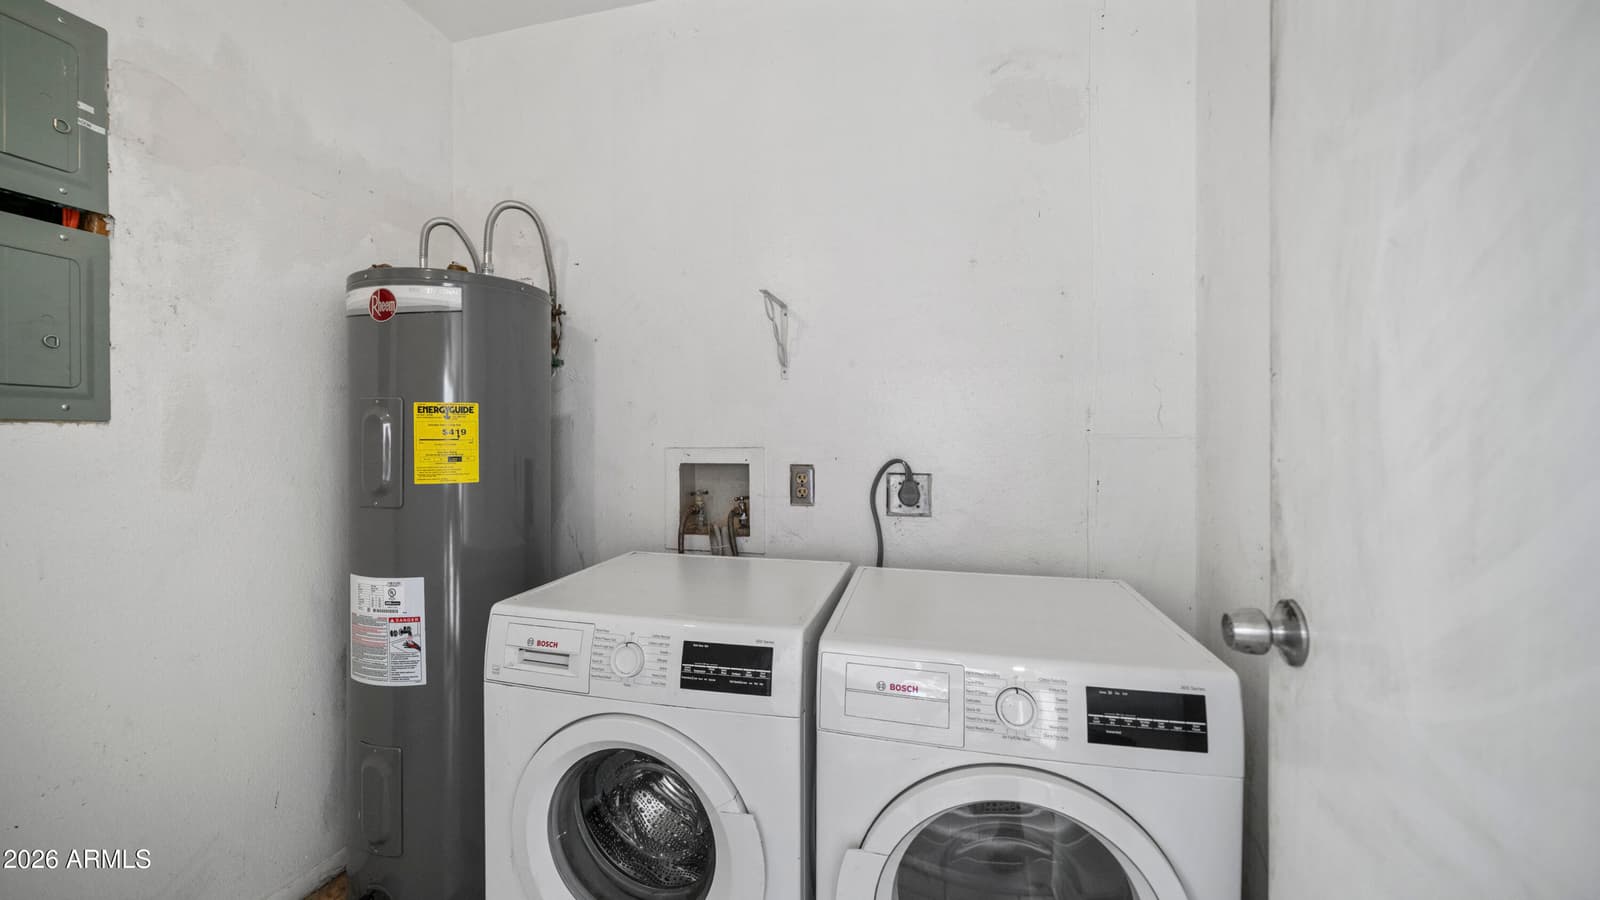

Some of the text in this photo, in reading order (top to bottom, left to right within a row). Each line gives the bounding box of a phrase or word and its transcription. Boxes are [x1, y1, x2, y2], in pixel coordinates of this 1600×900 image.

[370, 289, 396, 317] Rheem
[536, 639, 559, 649] BOSCH
[889, 682, 919, 694] BOSCH
